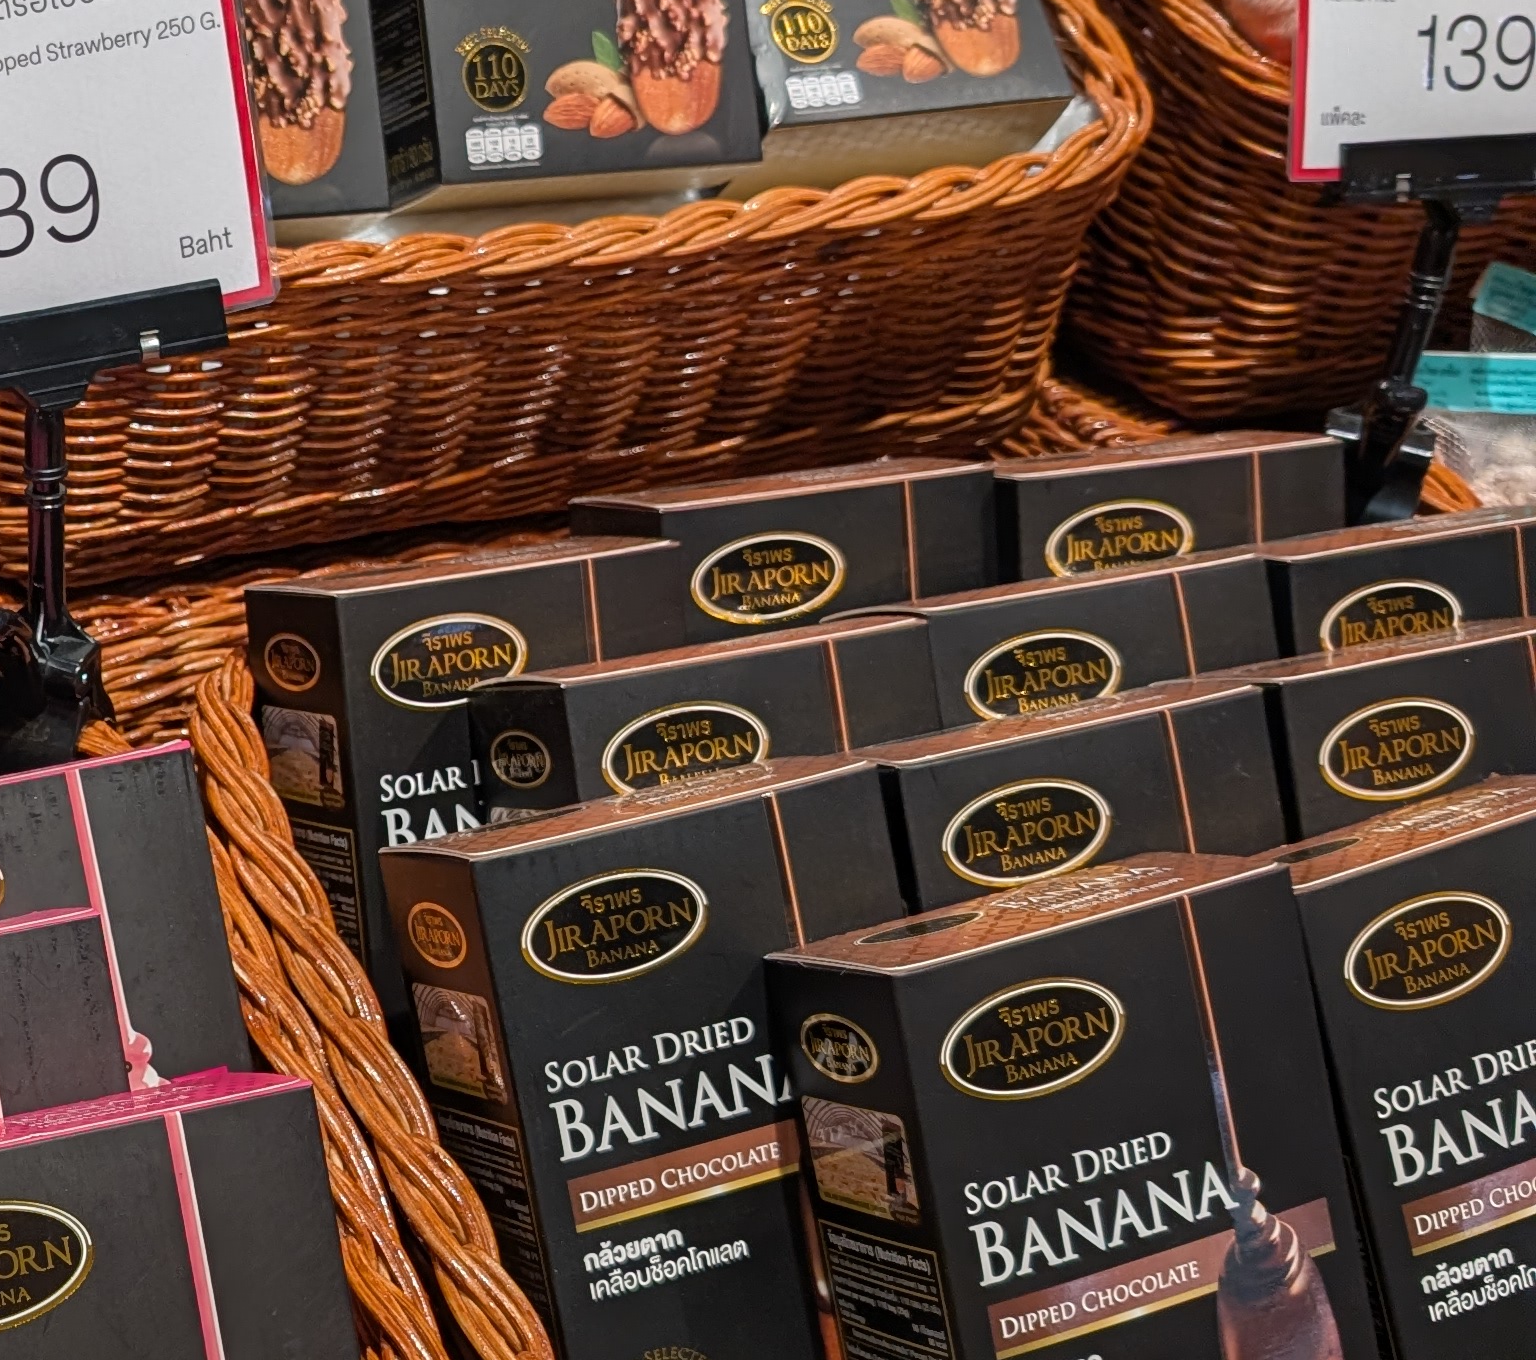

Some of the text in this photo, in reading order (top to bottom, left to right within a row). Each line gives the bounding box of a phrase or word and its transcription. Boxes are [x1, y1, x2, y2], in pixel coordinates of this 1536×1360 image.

[45, 25, 153, 66] Strawberry
[155, 15, 195, 41] 250
[199, 11, 221, 31] G.
[1417, 13, 1536, 93] 139
[178, 226, 234, 259] Baht
